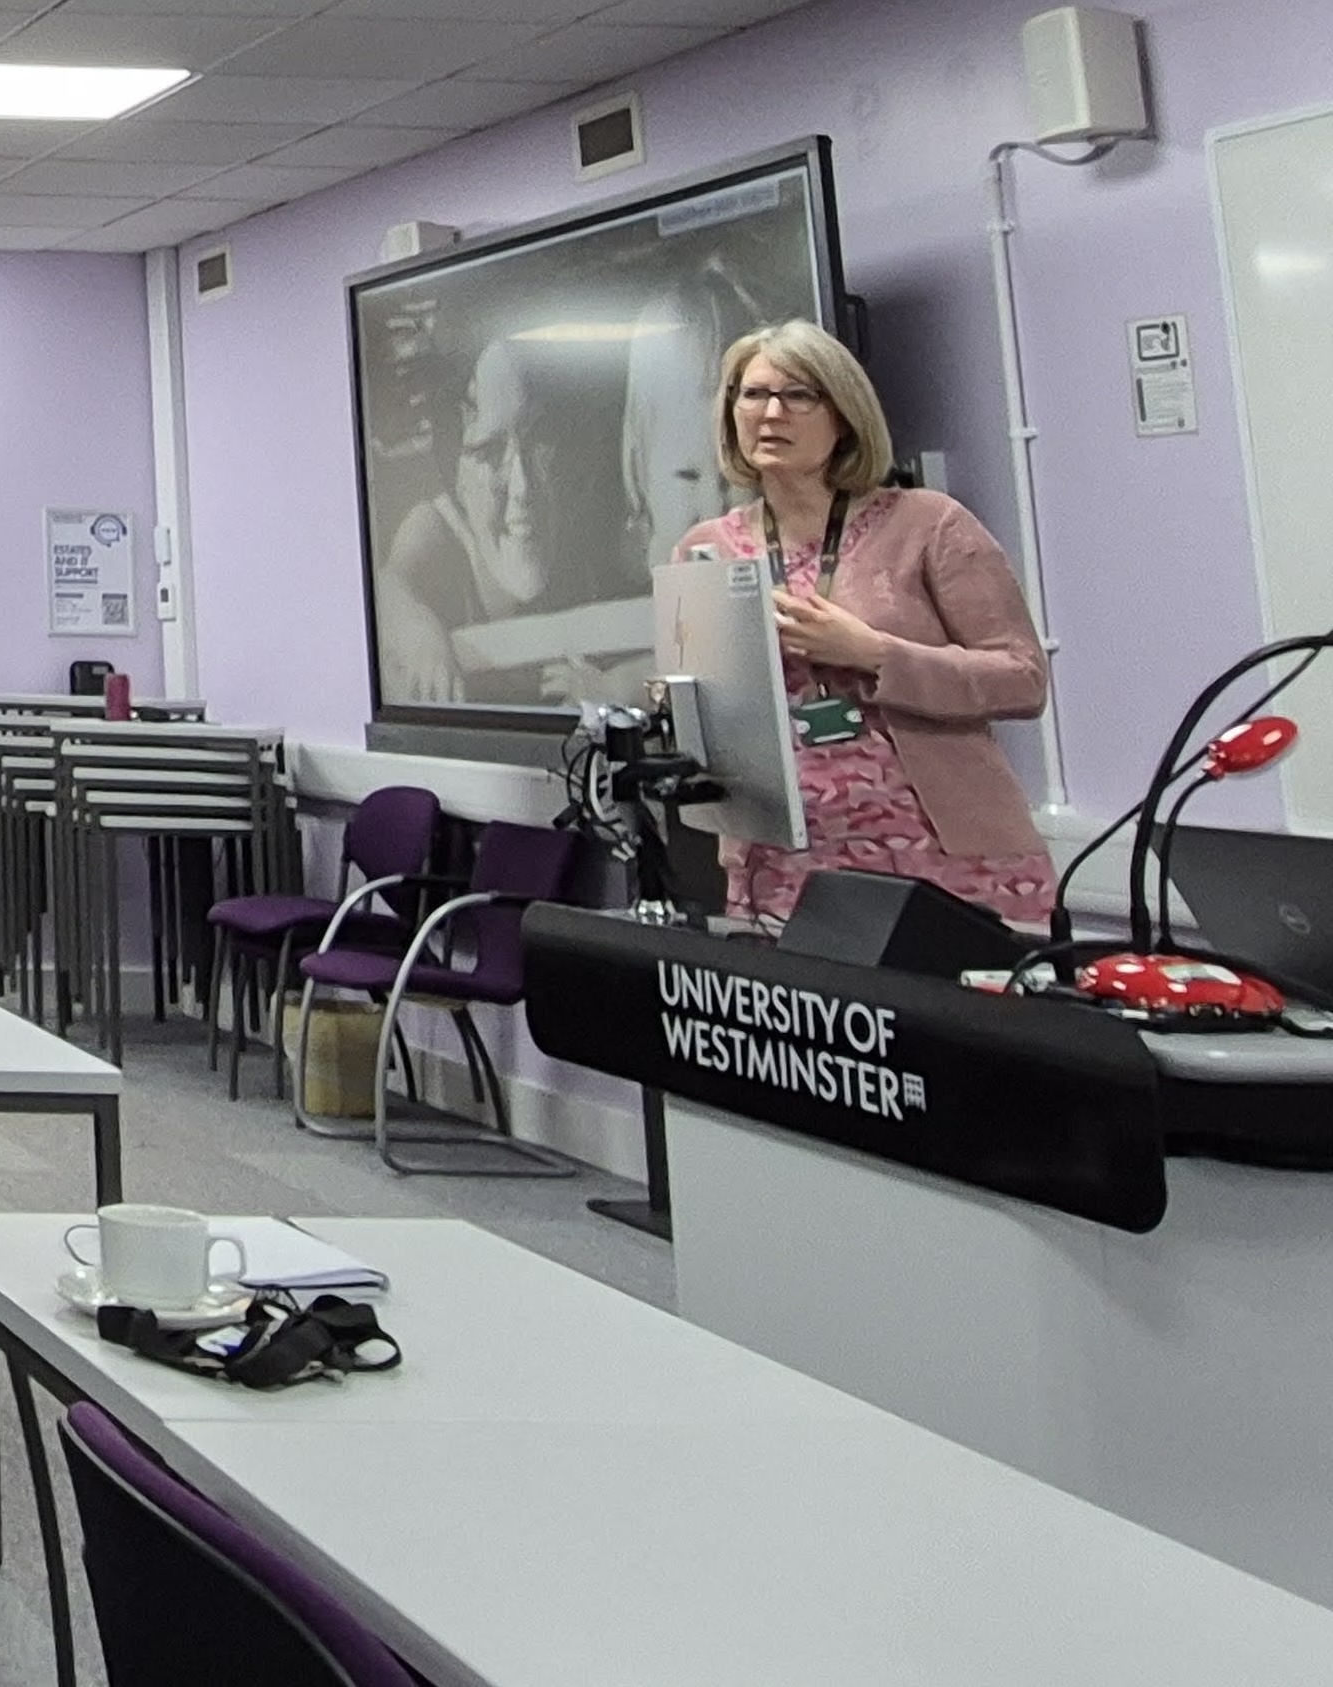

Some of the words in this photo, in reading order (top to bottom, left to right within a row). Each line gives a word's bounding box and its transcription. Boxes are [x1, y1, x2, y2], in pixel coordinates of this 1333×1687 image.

[657, 959, 840, 1045] UNIVERSITY
[843, 1001, 896, 1058] OF
[661, 1011, 904, 1121] WESTMINSTER
